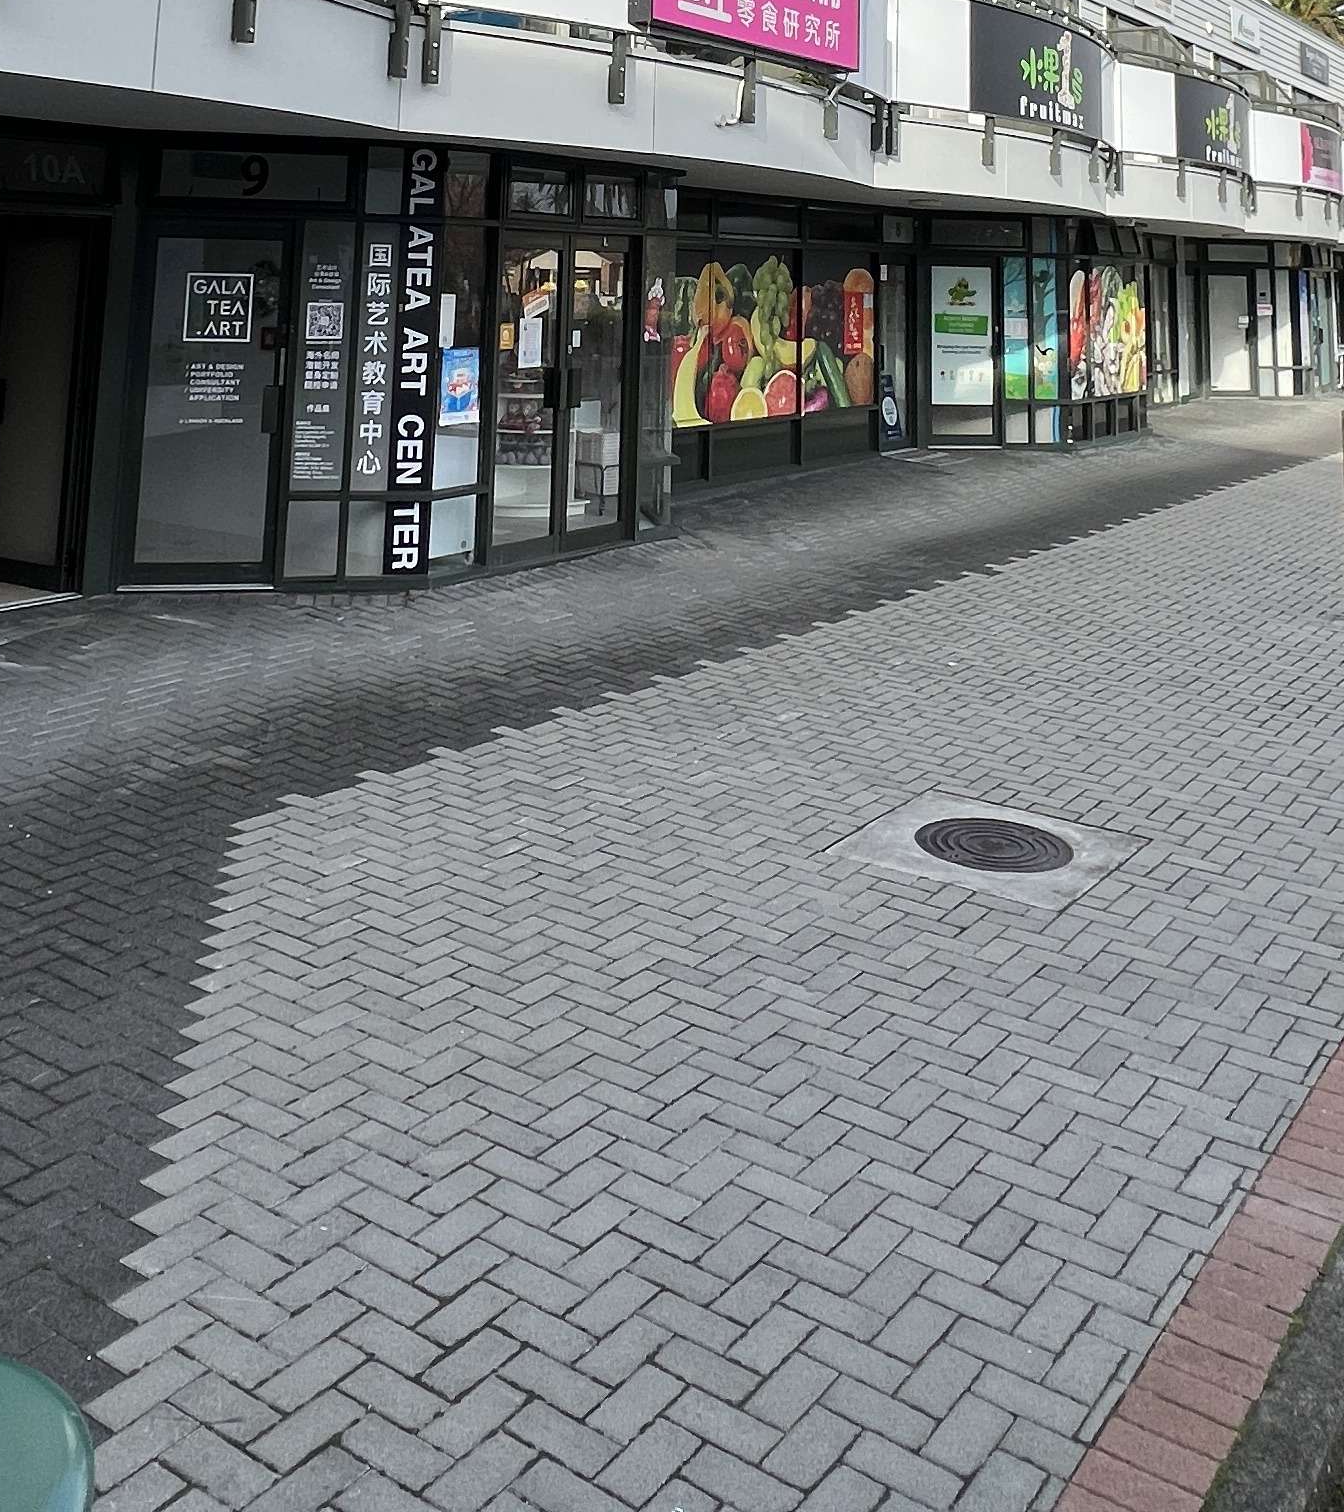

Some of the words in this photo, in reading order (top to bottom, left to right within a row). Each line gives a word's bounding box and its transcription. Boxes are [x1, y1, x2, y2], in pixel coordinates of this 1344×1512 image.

[240, 155, 270, 196] 9
[193, 279, 246, 295] GALA
[206, 300, 246, 316] TEA
[356, 243, 393, 475] 国际艺术教育中心
[400, 327, 429, 397] ART
